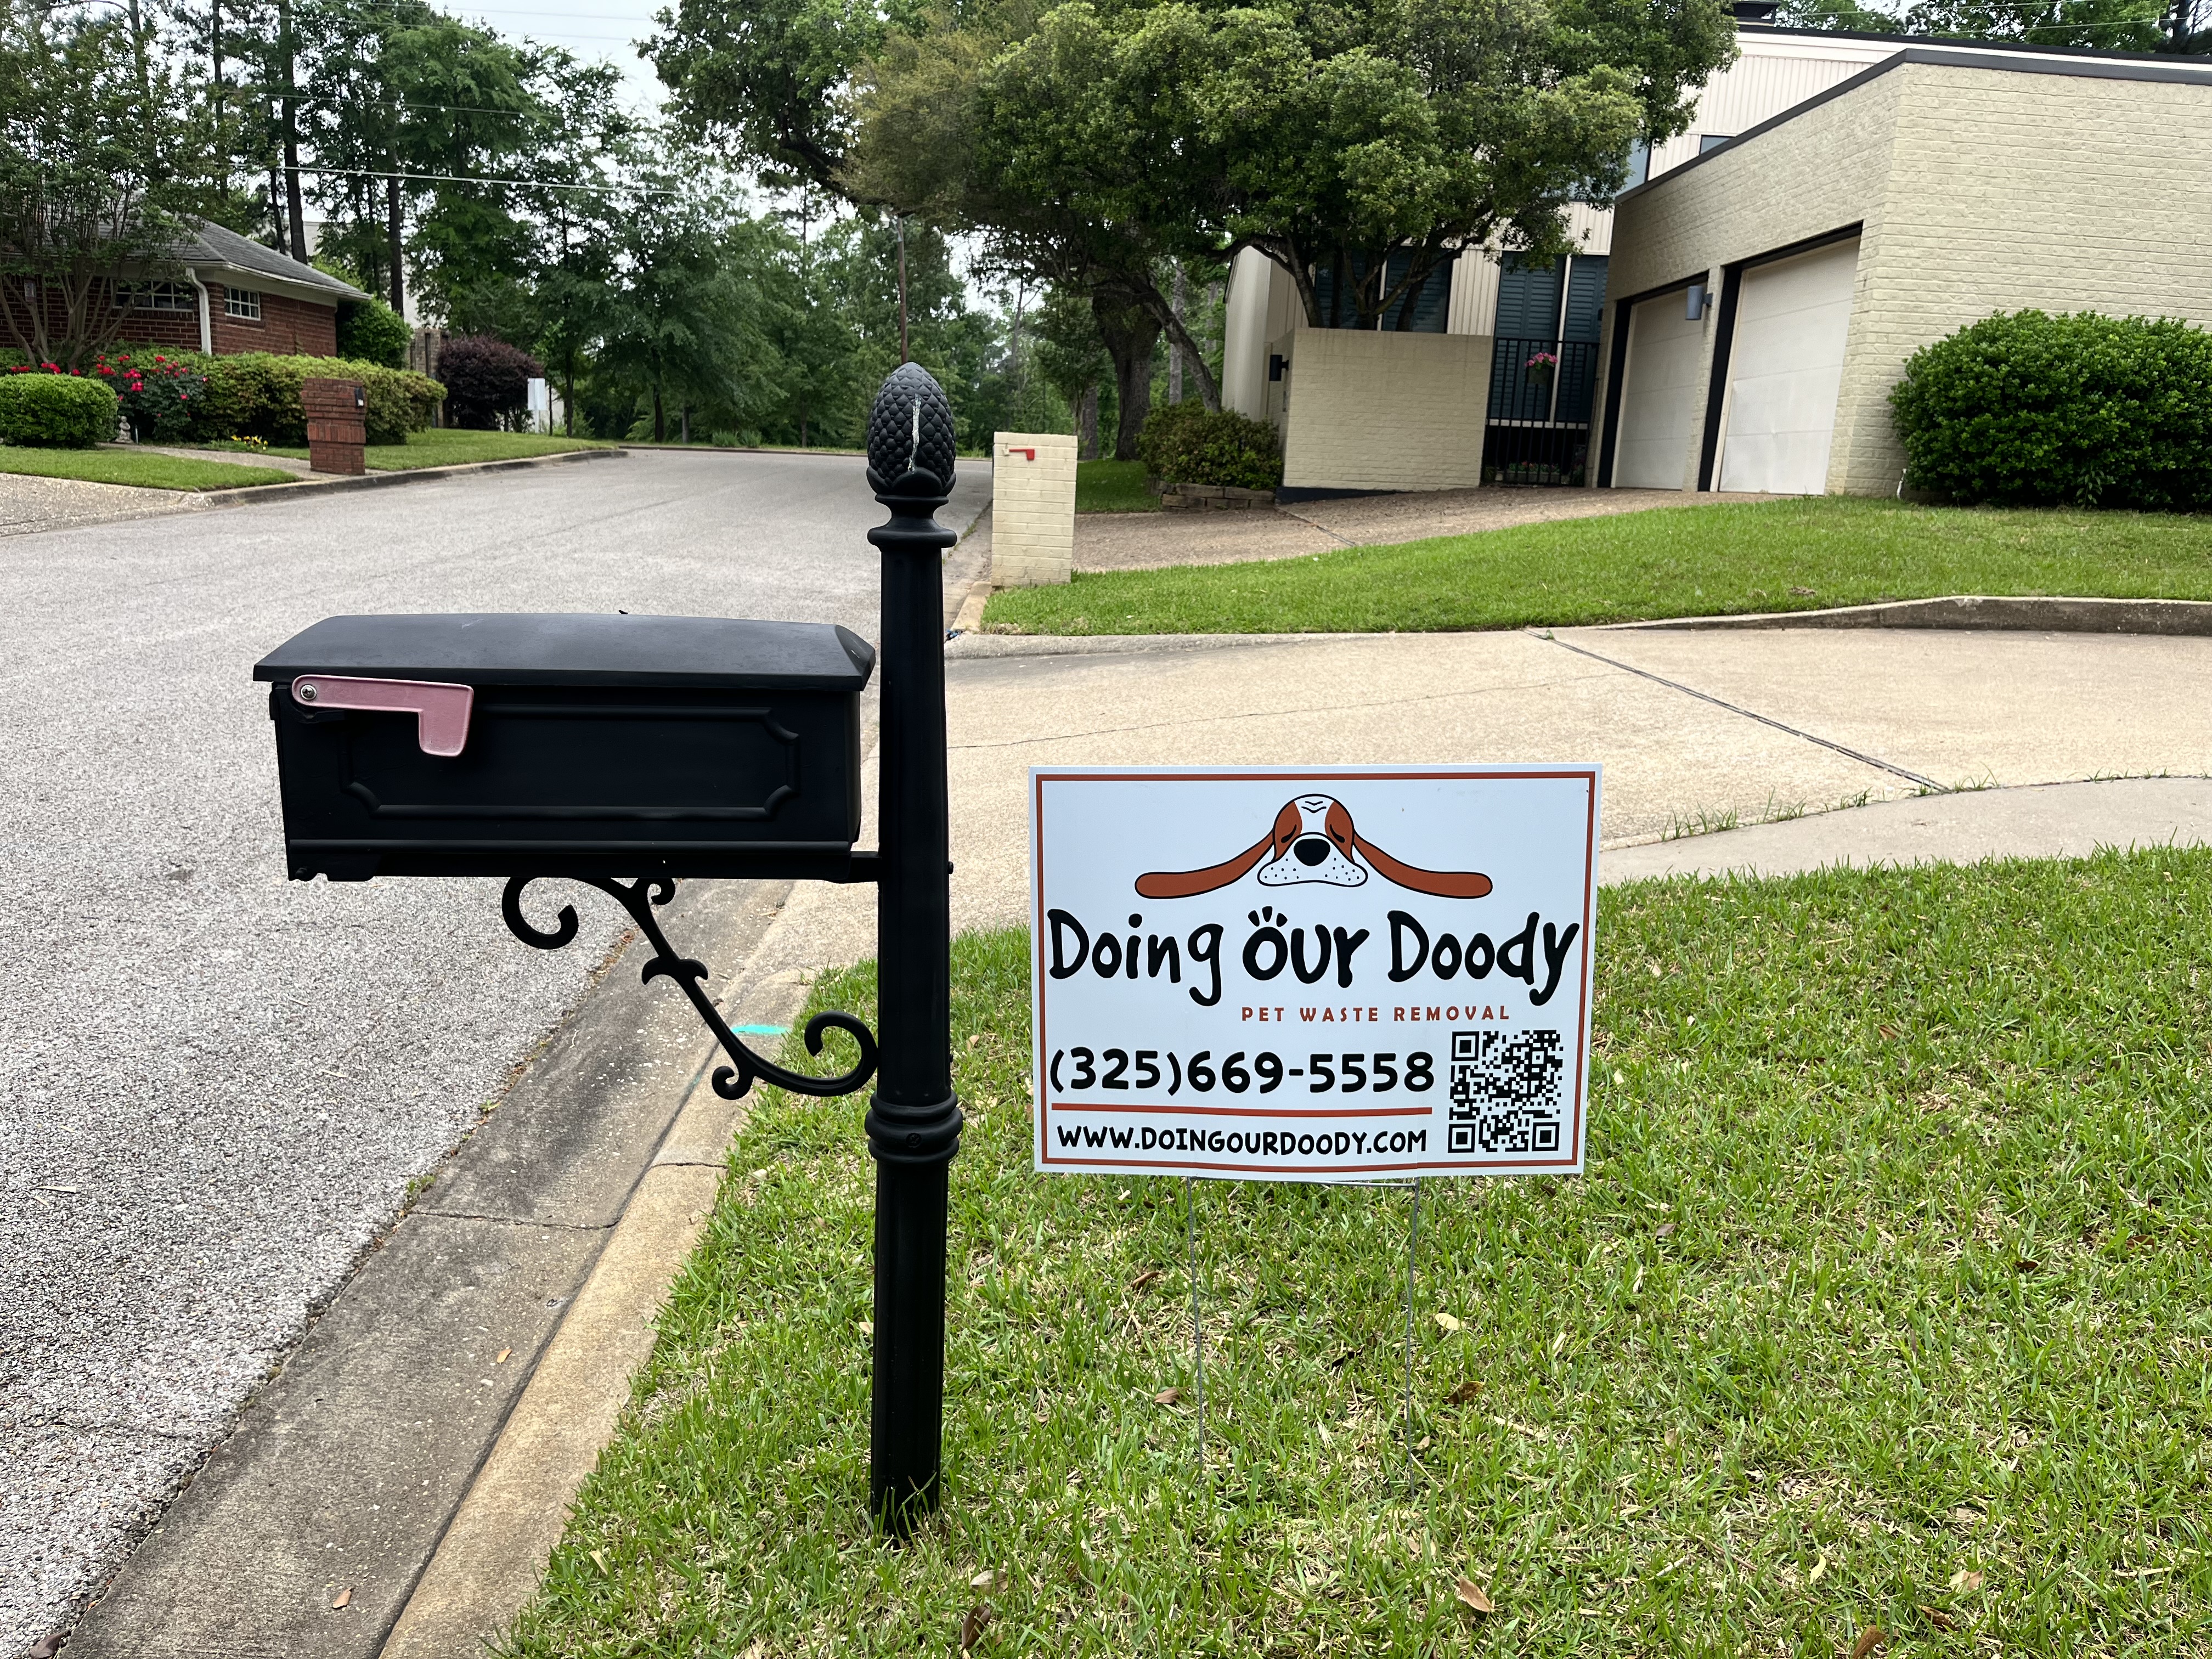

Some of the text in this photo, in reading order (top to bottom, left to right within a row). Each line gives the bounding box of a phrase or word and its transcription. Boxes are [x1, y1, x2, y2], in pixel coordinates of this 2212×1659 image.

[1047, 908, 1224, 1007] Doing
[1386, 910, 1580, 1006] Doody
[1242, 1005, 1510, 1023] PET WASTE REMOVAL
[1049, 1046, 1435, 1096] (325)669-5558
[1056, 1125, 1427, 1156] WWW.DOINGOURDOODY.COM
